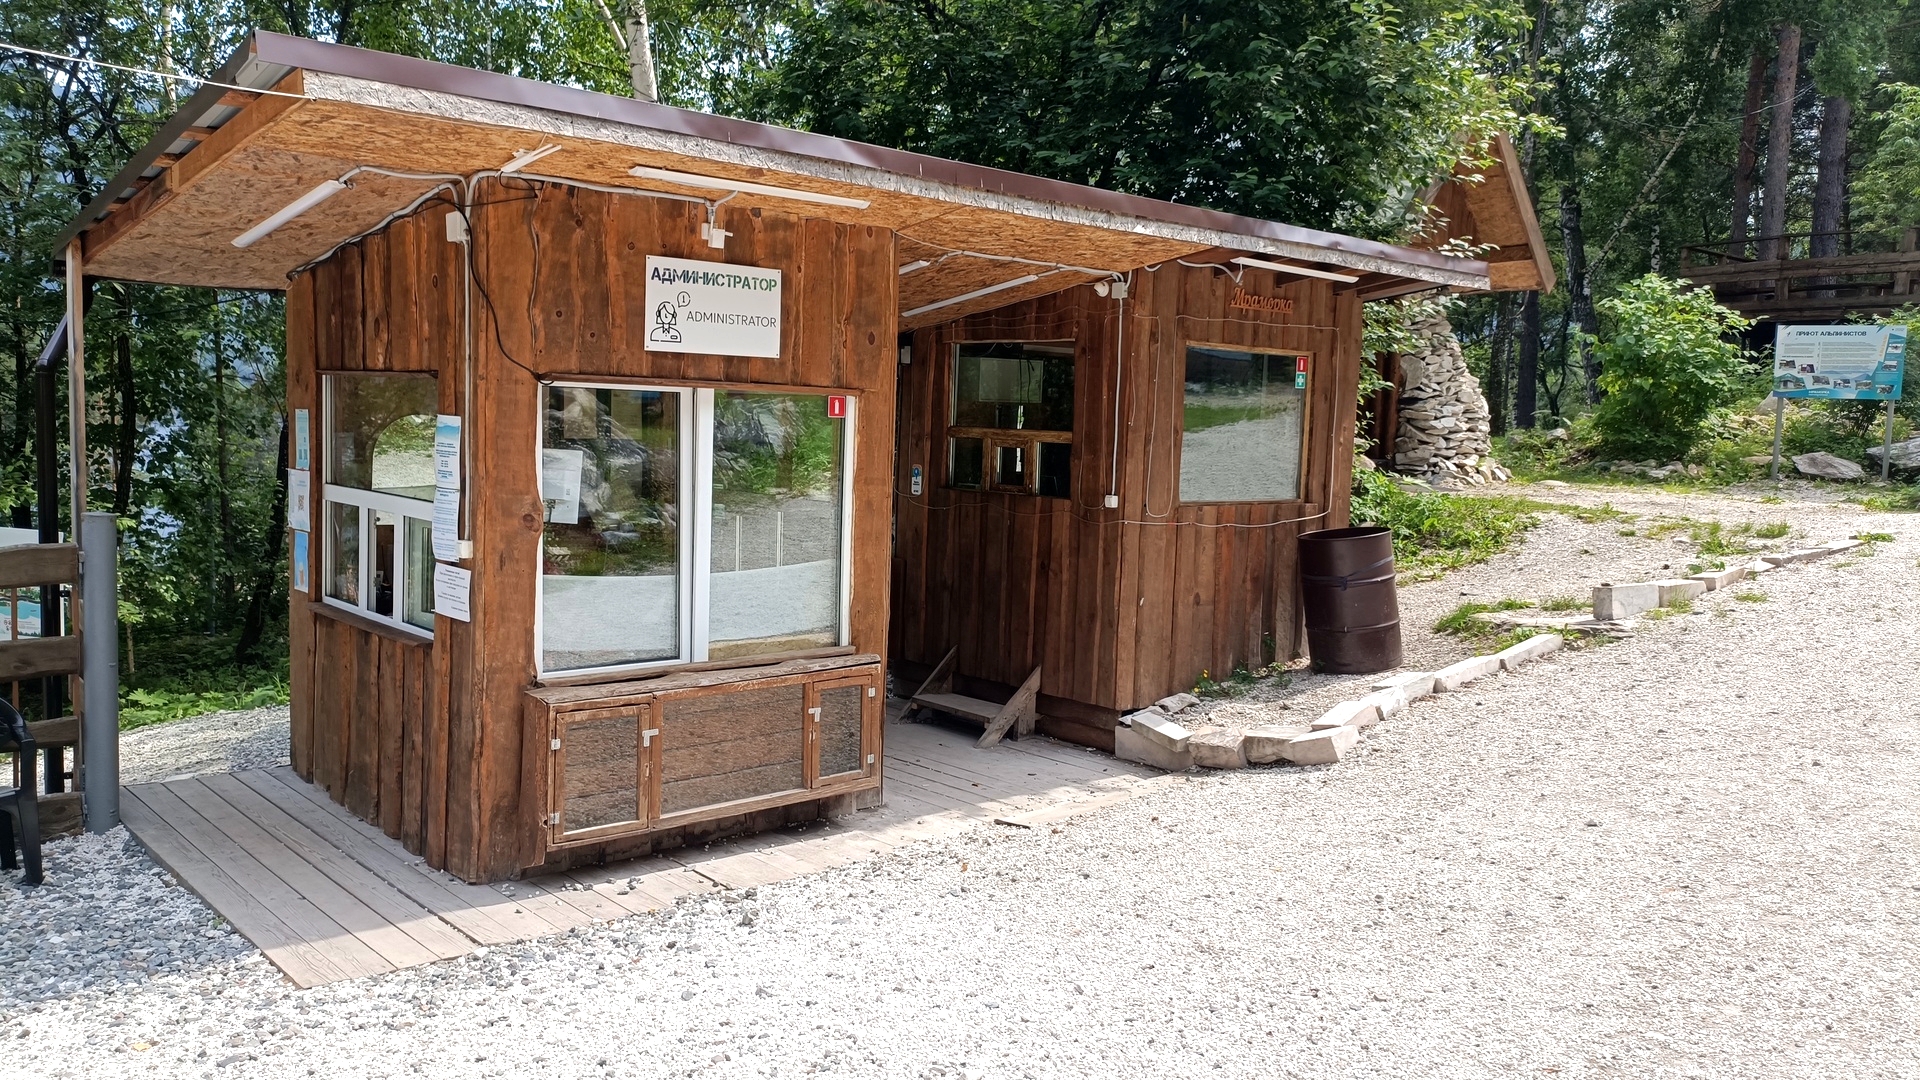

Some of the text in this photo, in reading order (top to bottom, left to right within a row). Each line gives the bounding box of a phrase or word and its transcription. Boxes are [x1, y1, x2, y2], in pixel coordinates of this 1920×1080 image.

[651, 267, 777, 291] АДМИНИСТРАТОР
[1230, 287, 1293, 313] Мраморка
[686, 311, 777, 328] ADMINISTRATOR
